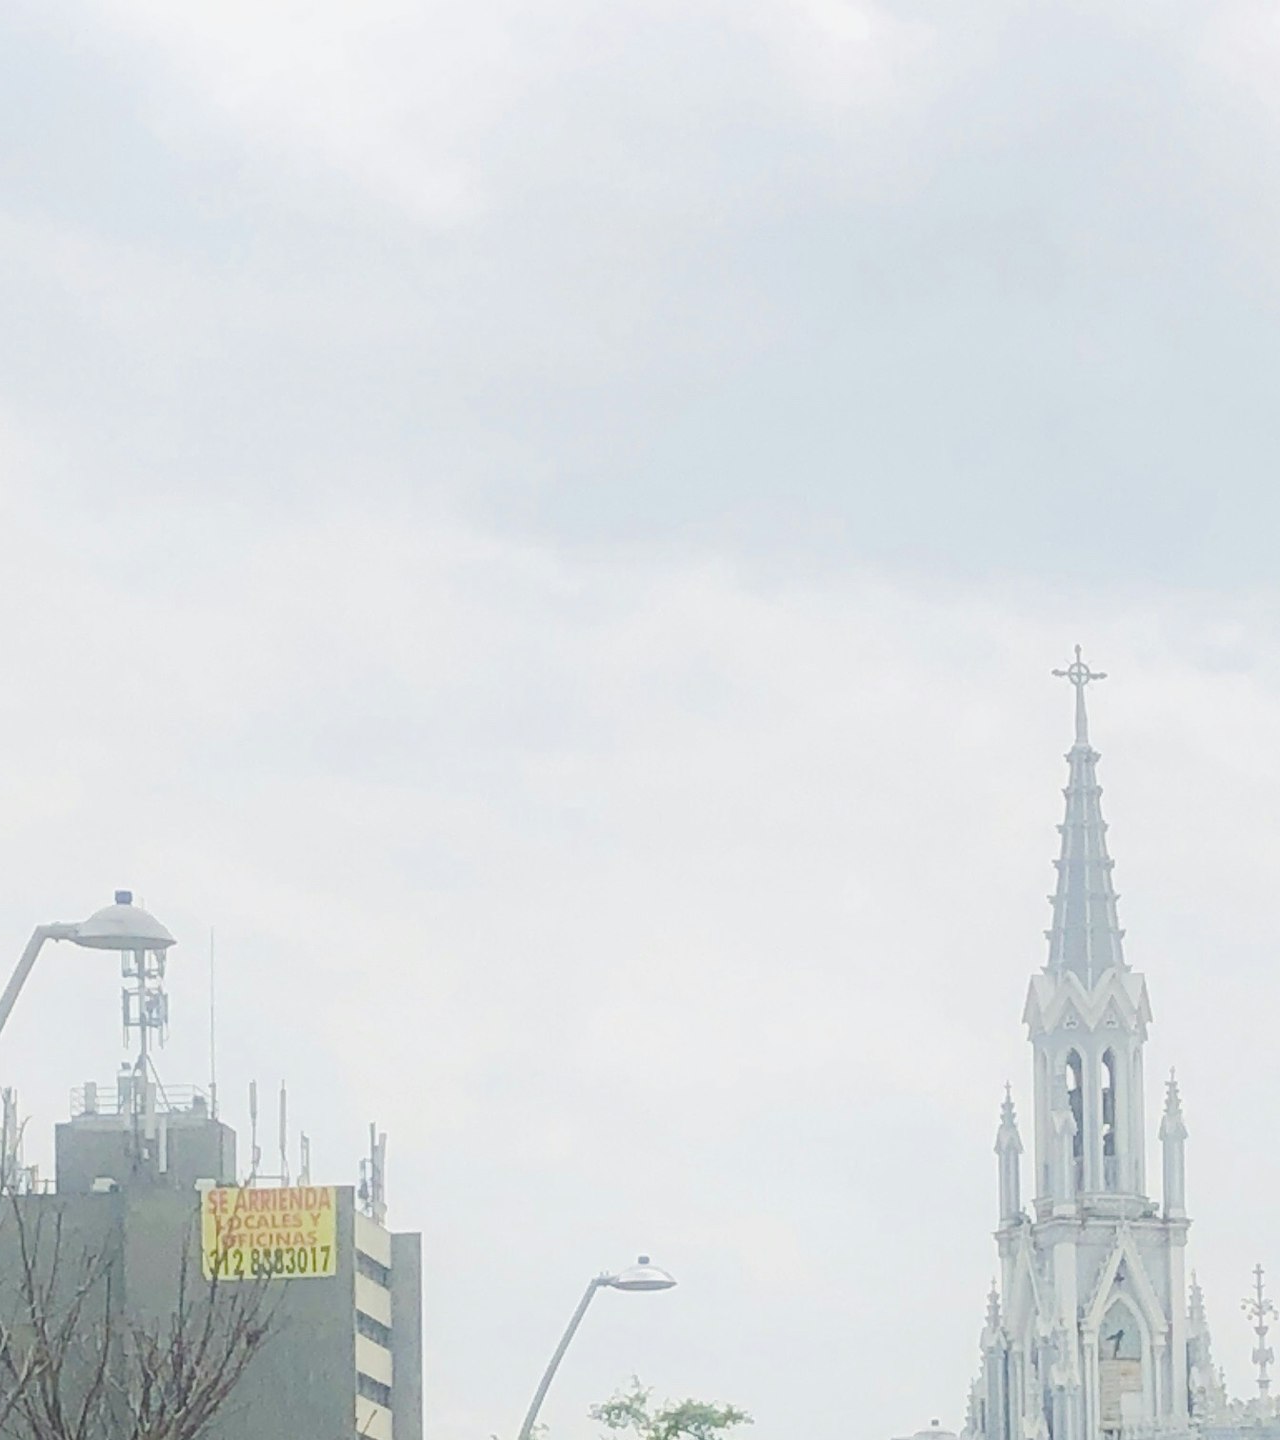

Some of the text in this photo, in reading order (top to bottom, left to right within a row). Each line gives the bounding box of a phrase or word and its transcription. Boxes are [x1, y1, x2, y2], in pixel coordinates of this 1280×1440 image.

[207, 1187, 331, 1213] SE ARRIENDA
[217, 1212, 322, 1230] LOCALES Y
[223, 1232, 318, 1248] OFICINAS
[209, 1249, 244, 1276] 312
